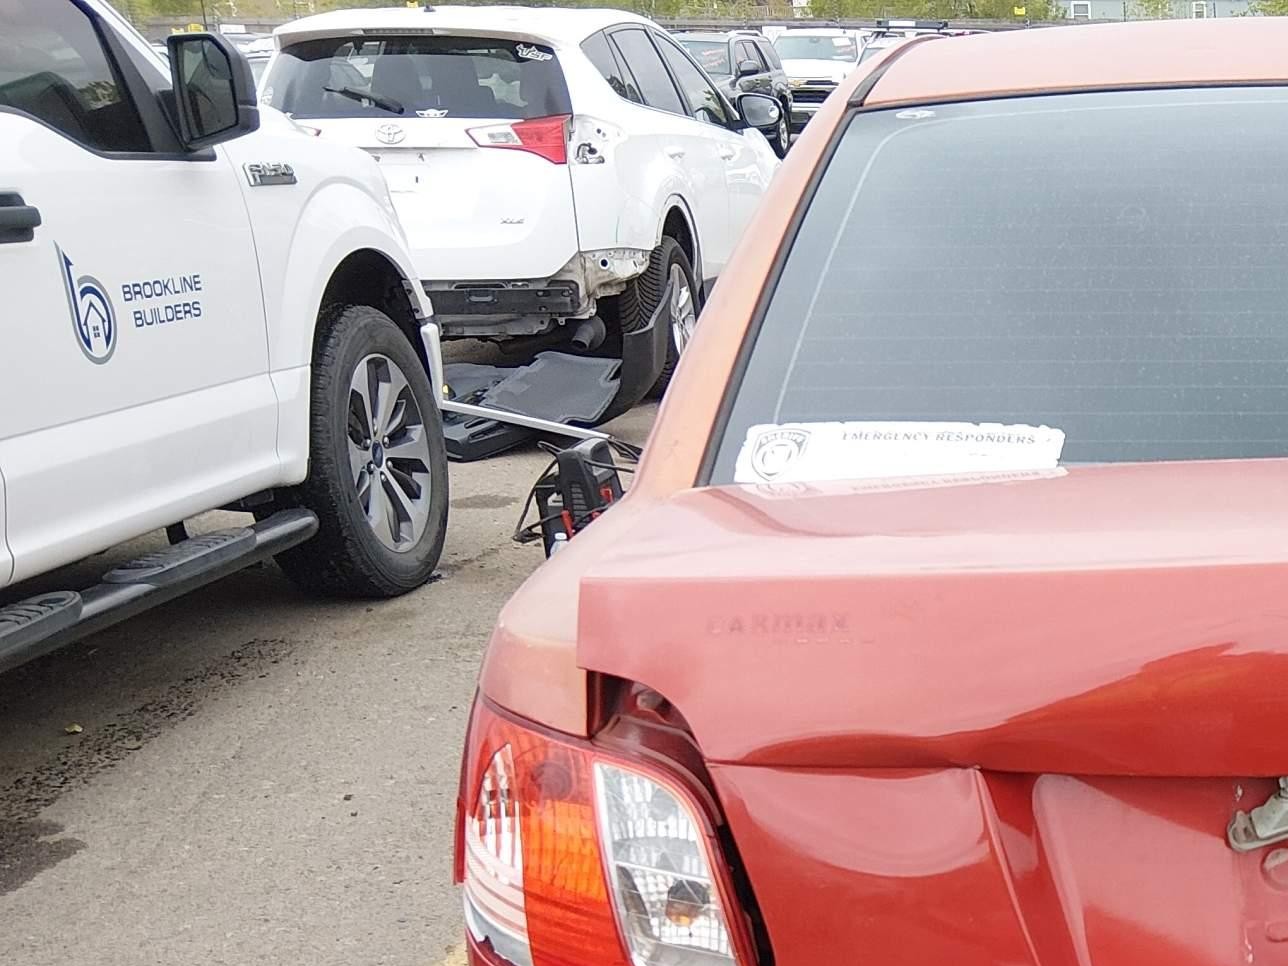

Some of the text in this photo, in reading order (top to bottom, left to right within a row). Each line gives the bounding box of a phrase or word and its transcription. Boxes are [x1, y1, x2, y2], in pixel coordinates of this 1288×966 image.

[121, 274, 202, 302] BROOKLINE
[133, 301, 202, 328] BUILDERS
[842, 430, 1036, 445] EMERGENCY RESPONDERS
